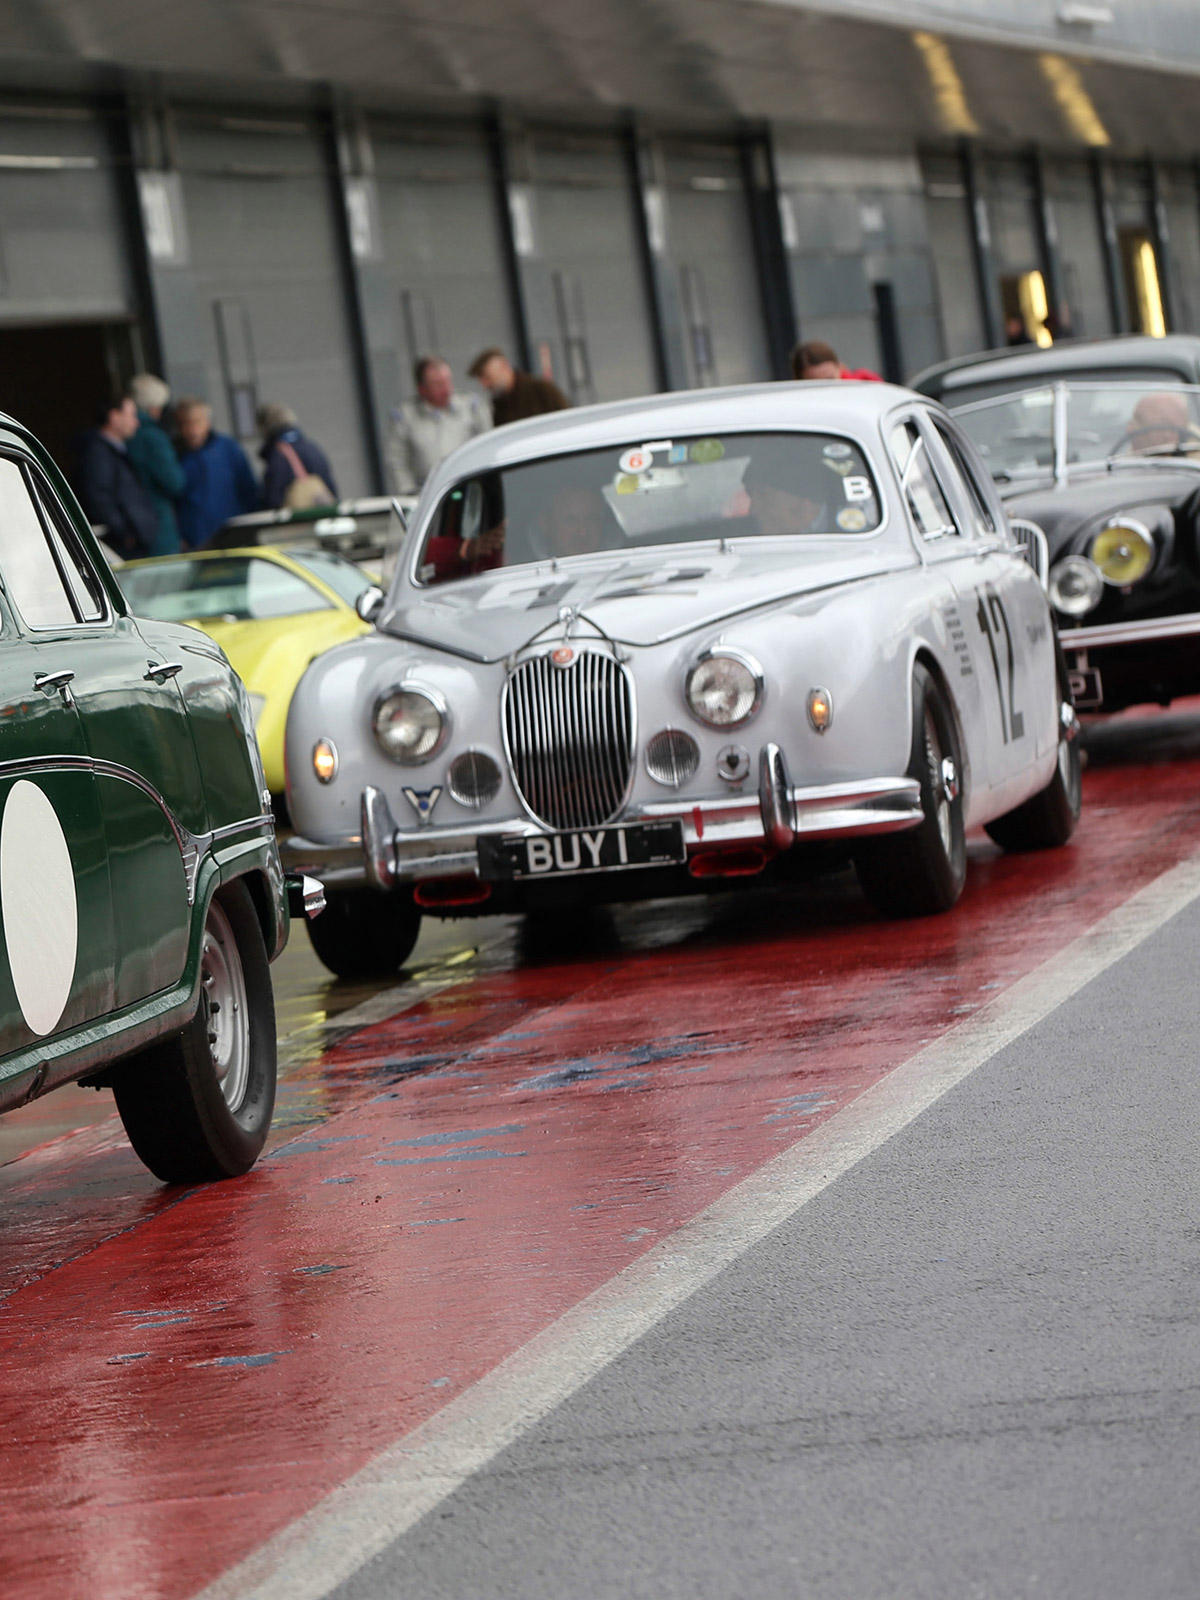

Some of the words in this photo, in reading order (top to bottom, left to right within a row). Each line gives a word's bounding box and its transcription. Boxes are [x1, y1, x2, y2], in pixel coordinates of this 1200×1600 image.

[842, 475, 872, 502] B
[973, 579, 1025, 745] 12
[526, 830, 606, 873] BUY
